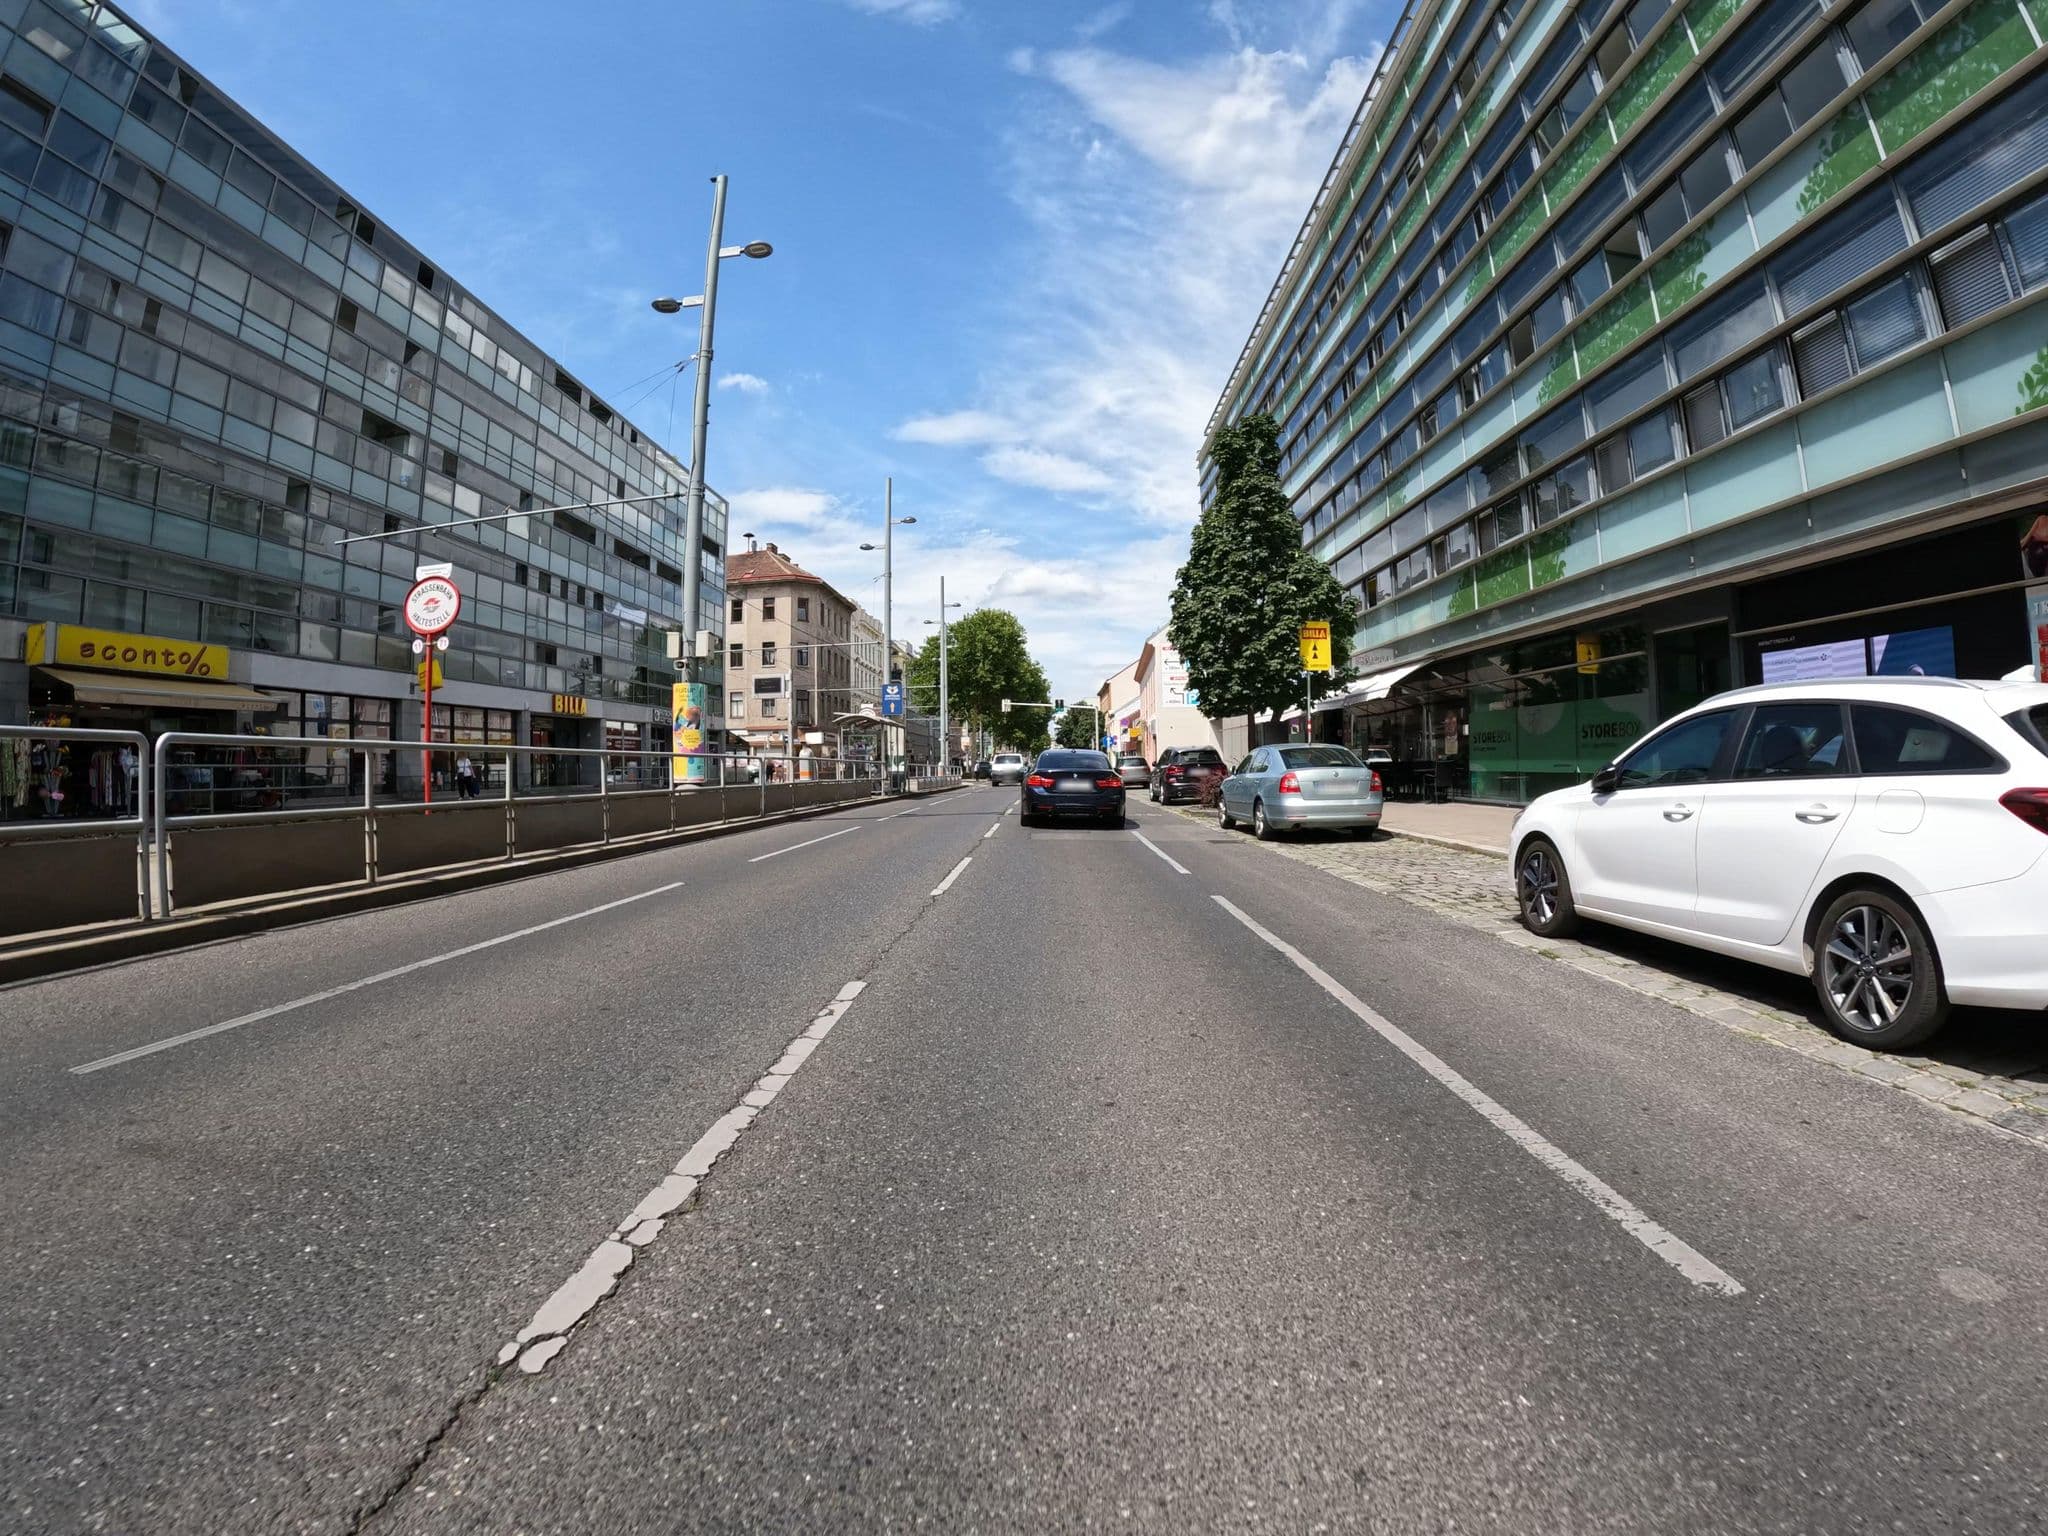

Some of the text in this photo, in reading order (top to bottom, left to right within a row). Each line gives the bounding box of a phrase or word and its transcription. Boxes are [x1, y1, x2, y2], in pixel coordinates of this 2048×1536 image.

[412, 583, 453, 603] STRASSENBAHN
[412, 609, 451, 627] HALTESTELLE
[1302, 628, 1327, 639] BILLA
[554, 693, 587, 716] BILLA
[1472, 730, 1512, 745] STOREBOX
[1581, 719, 1642, 739] STOREBOX
